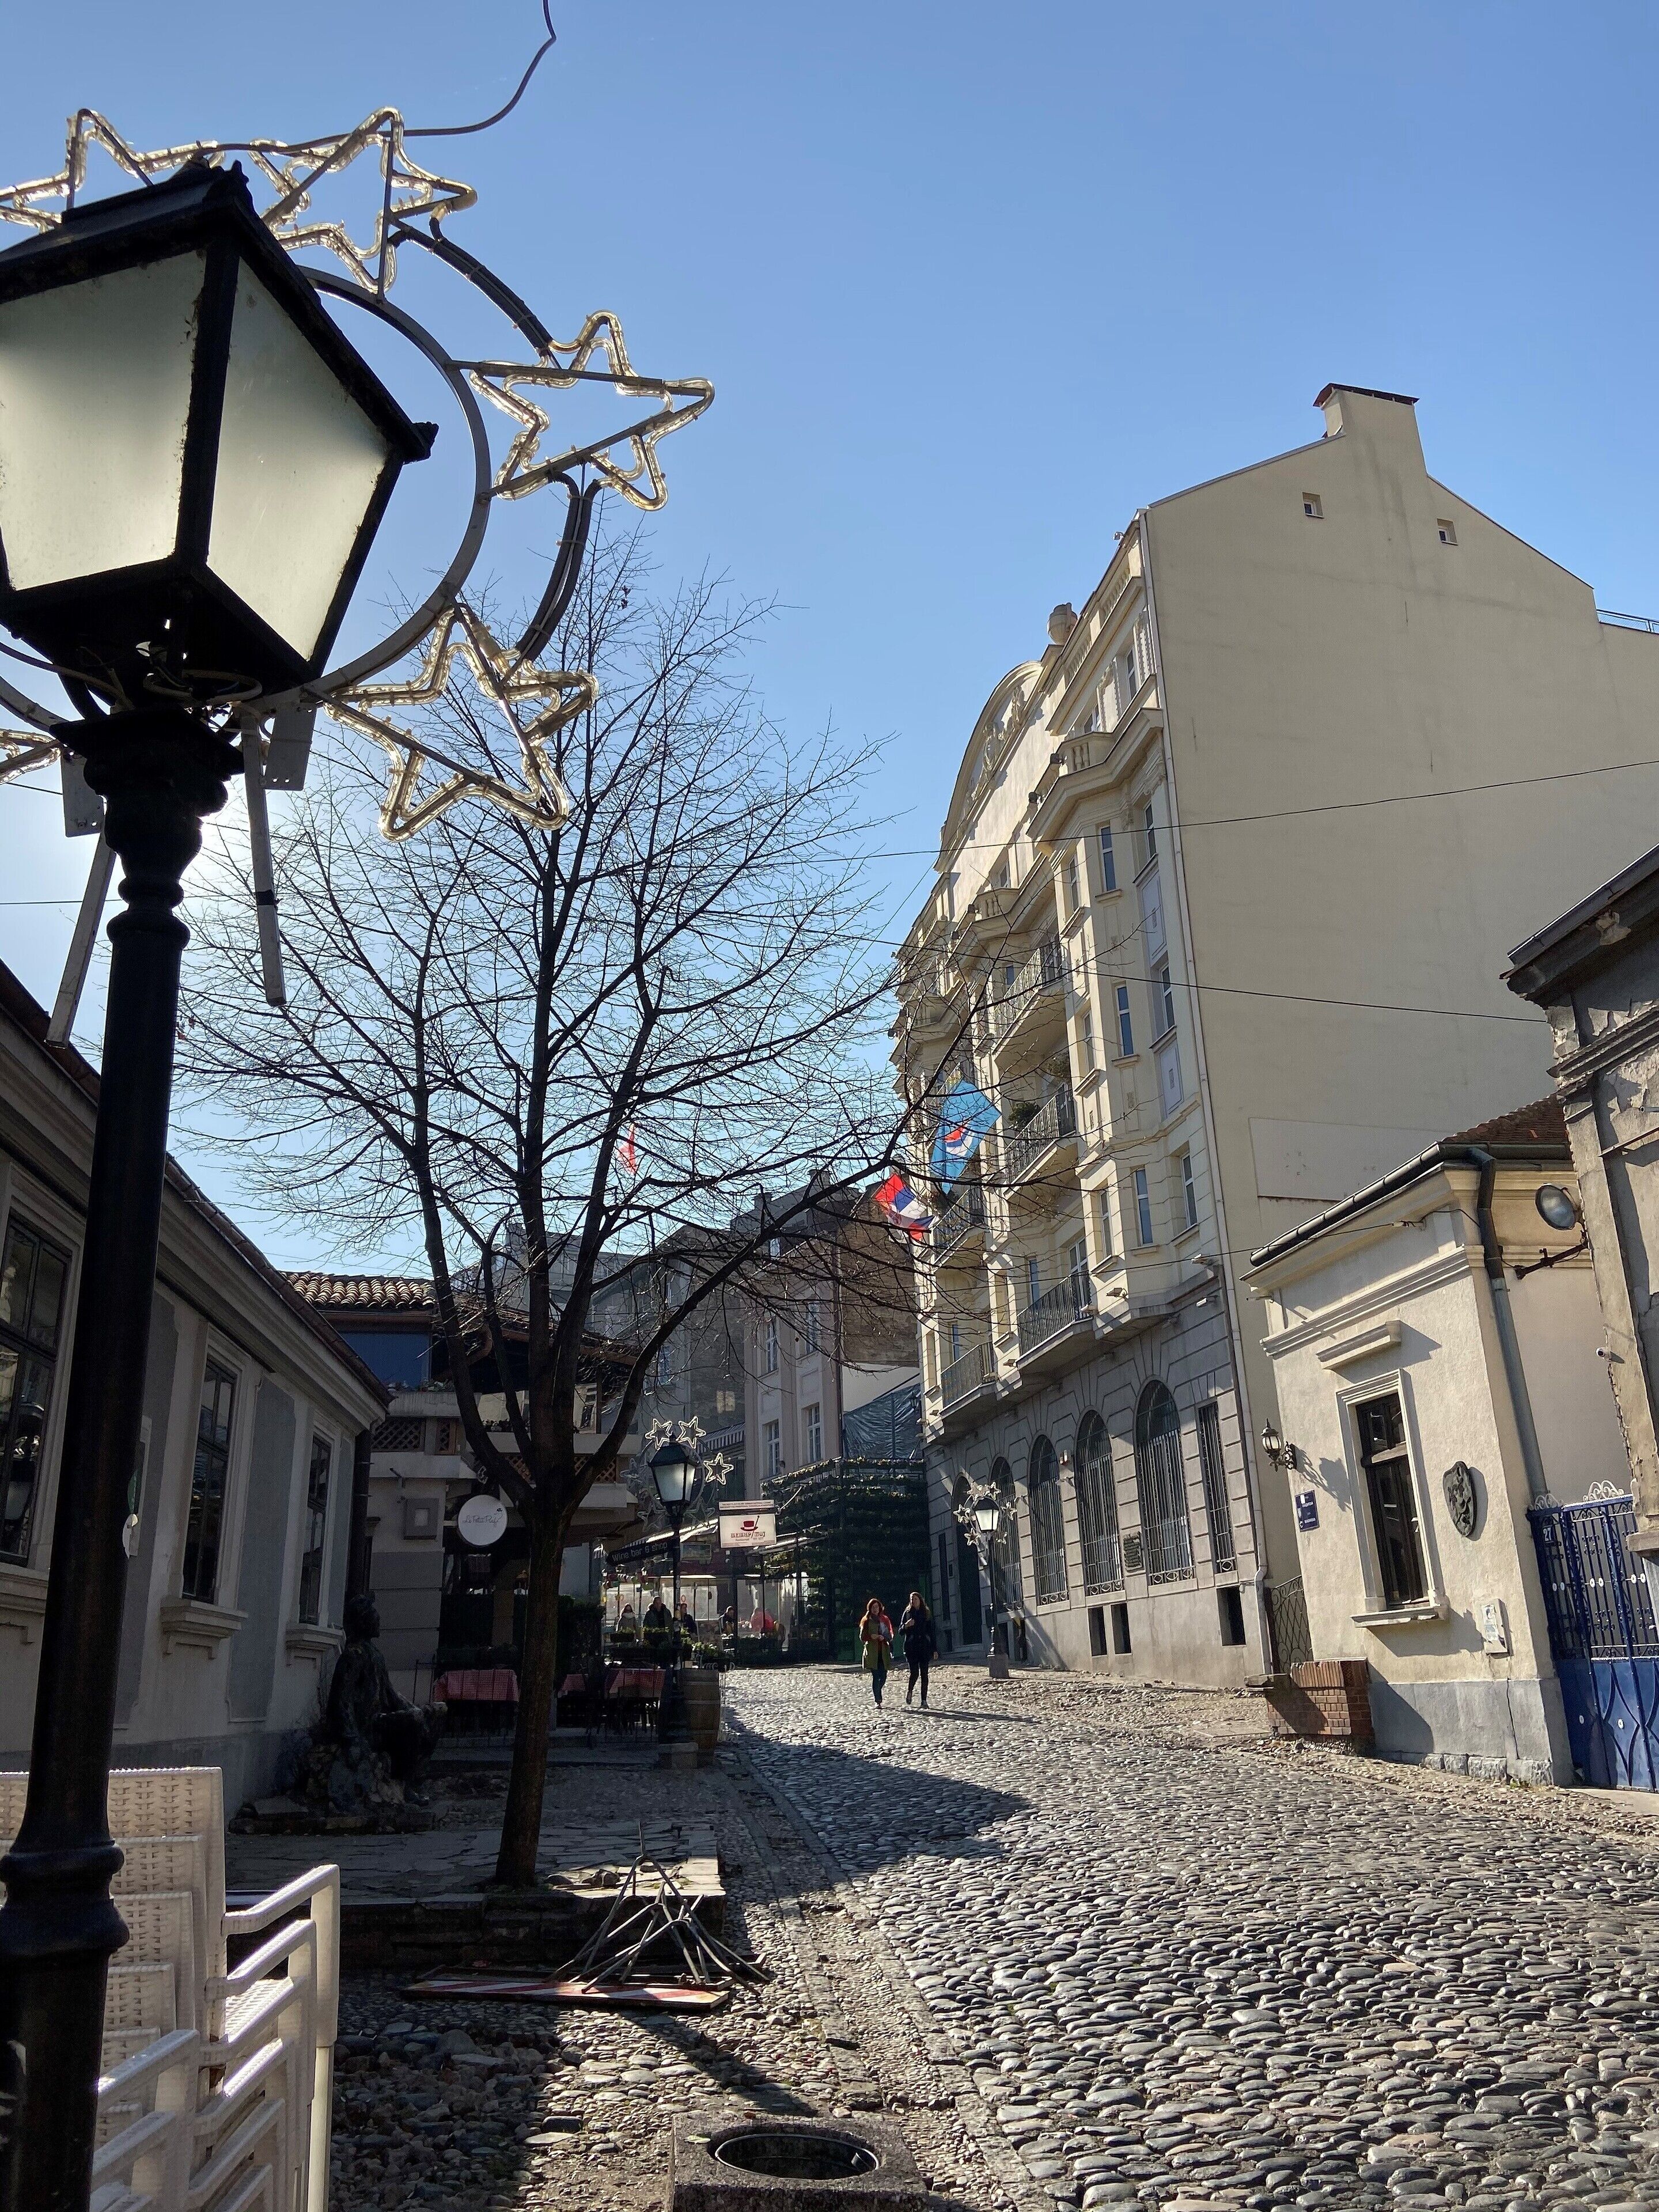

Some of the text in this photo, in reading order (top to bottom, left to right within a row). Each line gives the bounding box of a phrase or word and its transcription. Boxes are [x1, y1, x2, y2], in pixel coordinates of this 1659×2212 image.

[1543, 1528, 1551, 1541] 27
[631, 1548, 642, 1556] bar
[652, 1543, 668, 1551] shop
